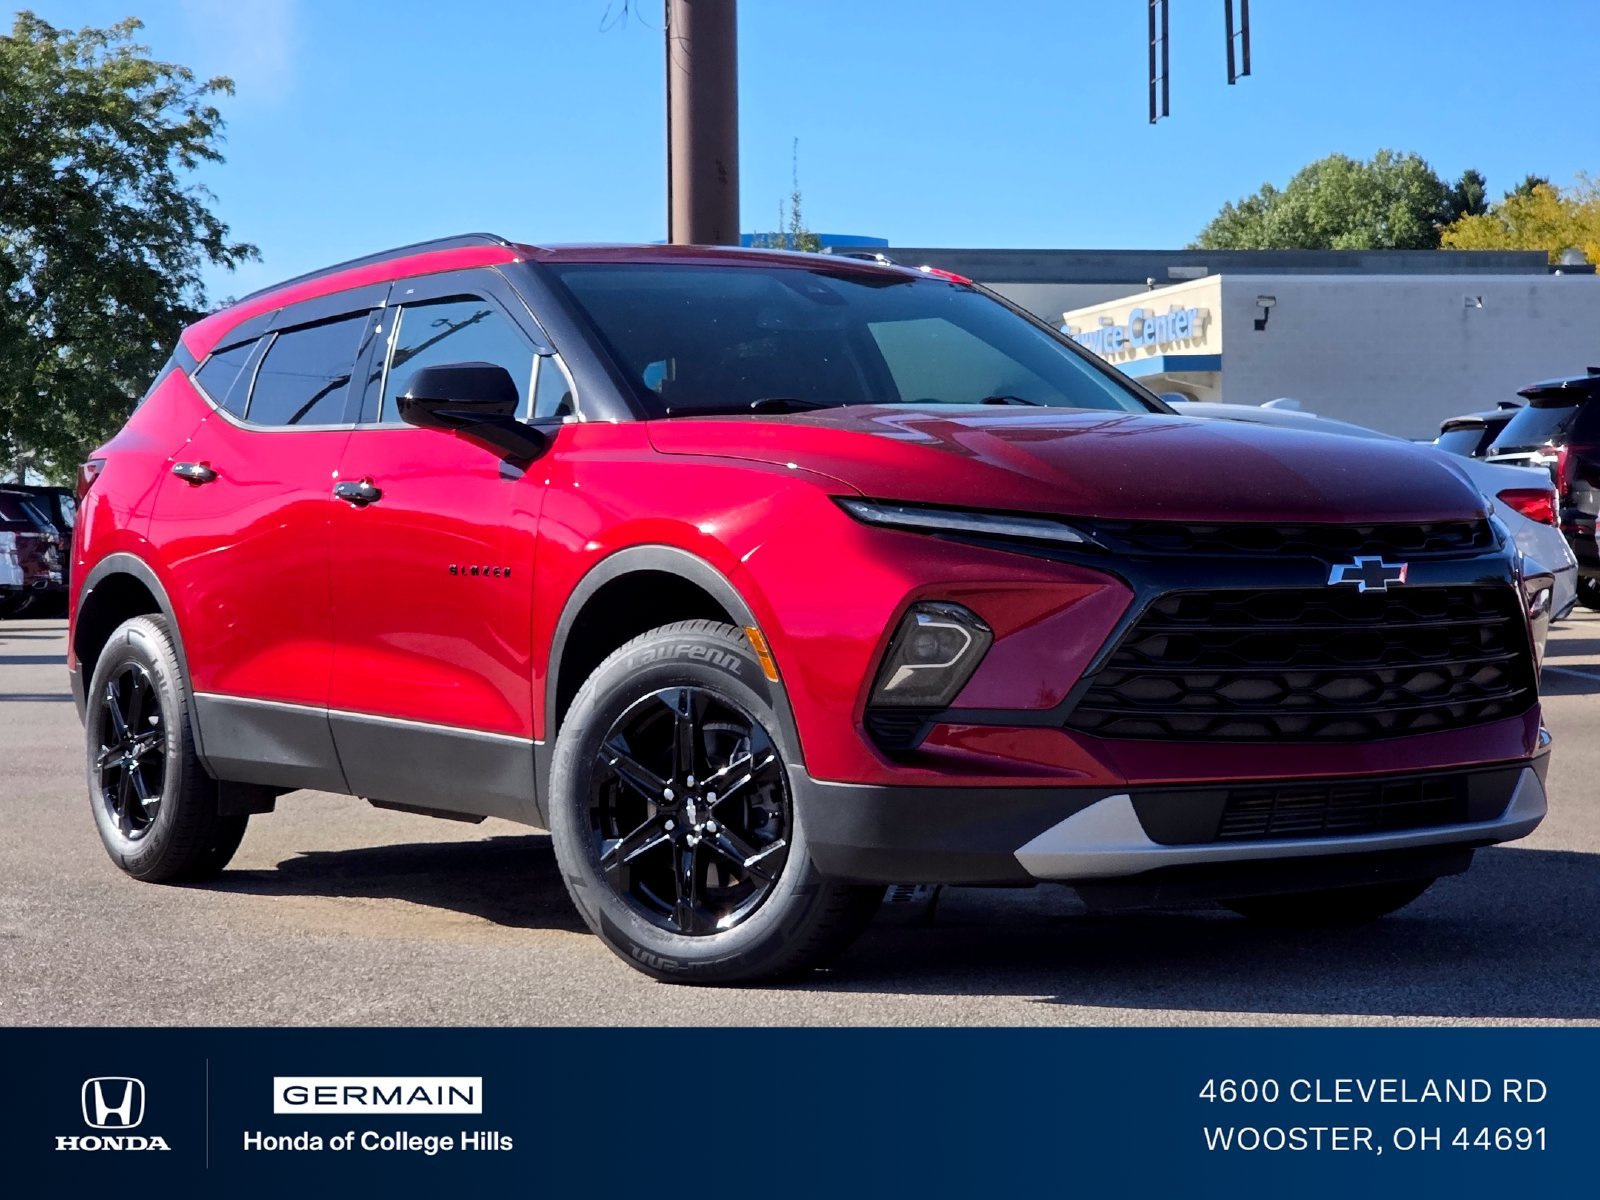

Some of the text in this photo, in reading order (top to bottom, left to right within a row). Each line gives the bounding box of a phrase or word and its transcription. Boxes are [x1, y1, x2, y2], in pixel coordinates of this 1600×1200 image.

[1128, 308, 1198, 348] Center
[448, 564, 511, 578] BLAZER
[625, 644, 742, 676] Laufenn
